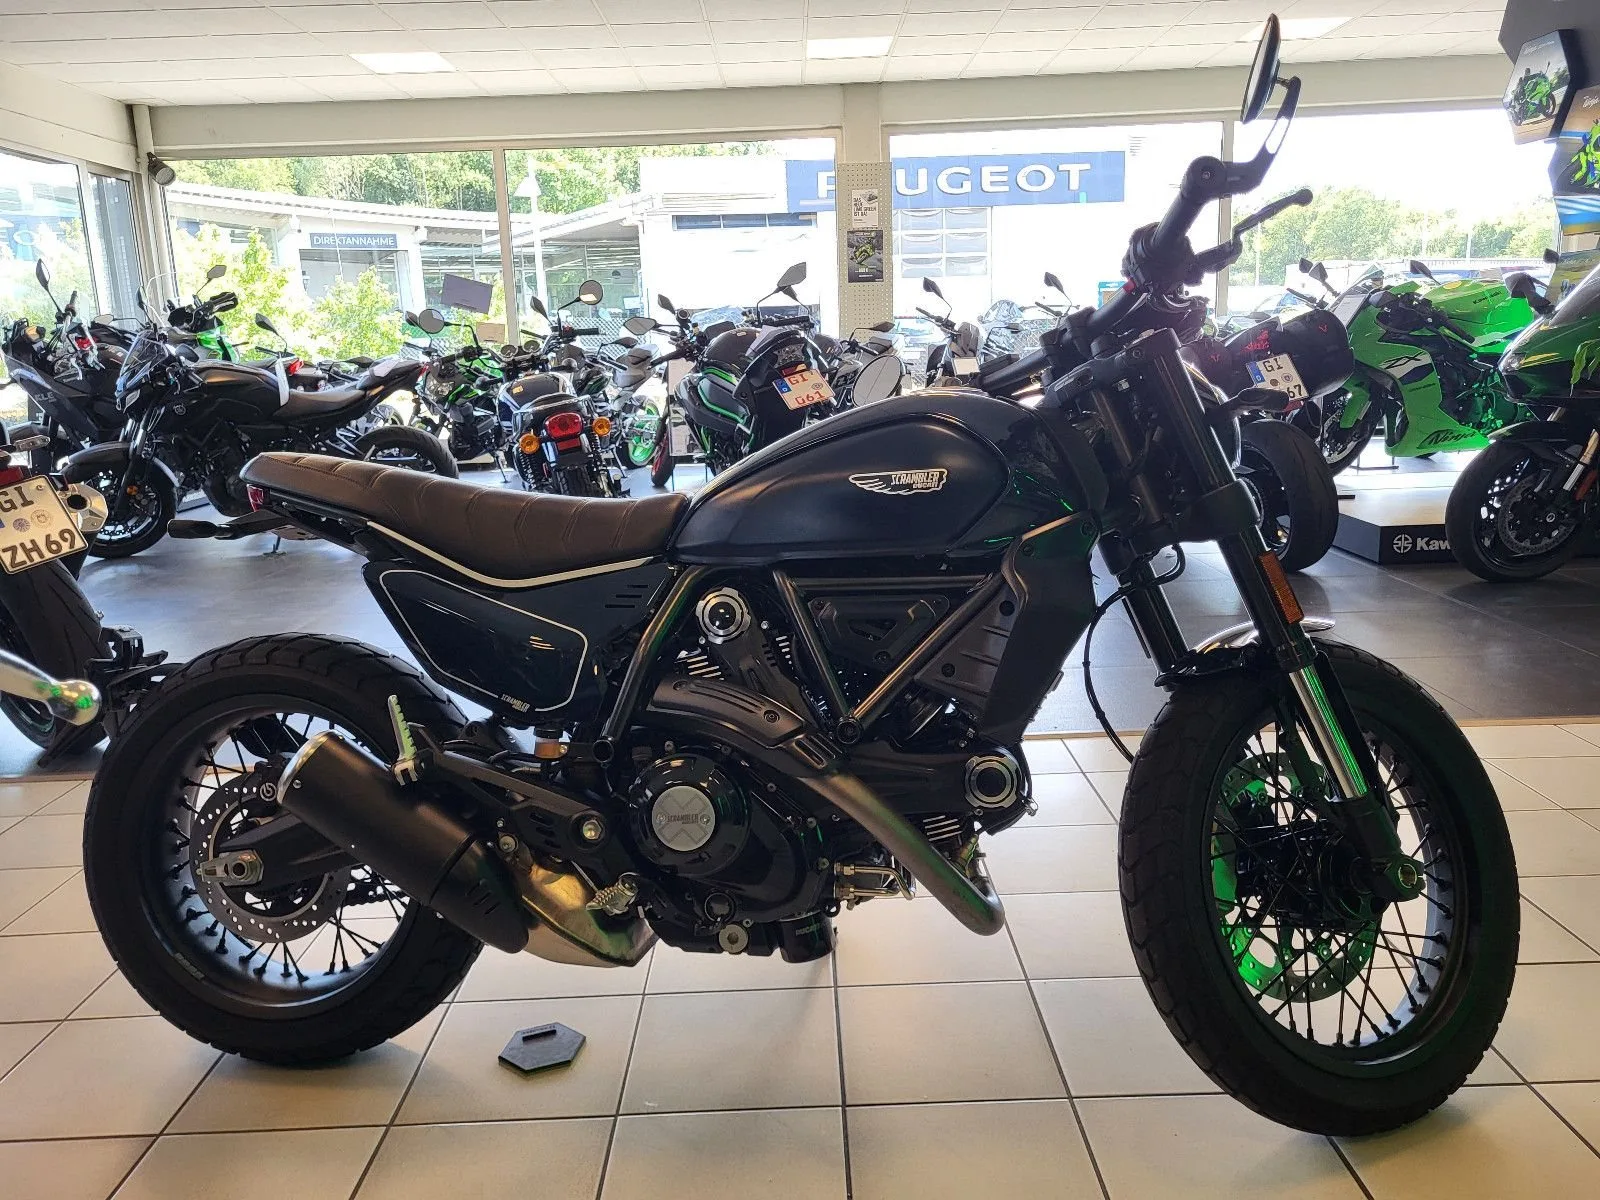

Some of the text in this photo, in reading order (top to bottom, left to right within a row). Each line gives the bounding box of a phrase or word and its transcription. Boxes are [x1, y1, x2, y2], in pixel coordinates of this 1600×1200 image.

[817, 163, 1091, 199] PUGEOT
[313, 235, 396, 246] DIREKTANNAHME
[1262, 358, 1284, 373] GI
[787, 374, 809, 385] GI
[890, 471, 940, 486] SCRAMBLER
[912, 481, 939, 489] DUCATI
[0, 485, 35, 513] GI
